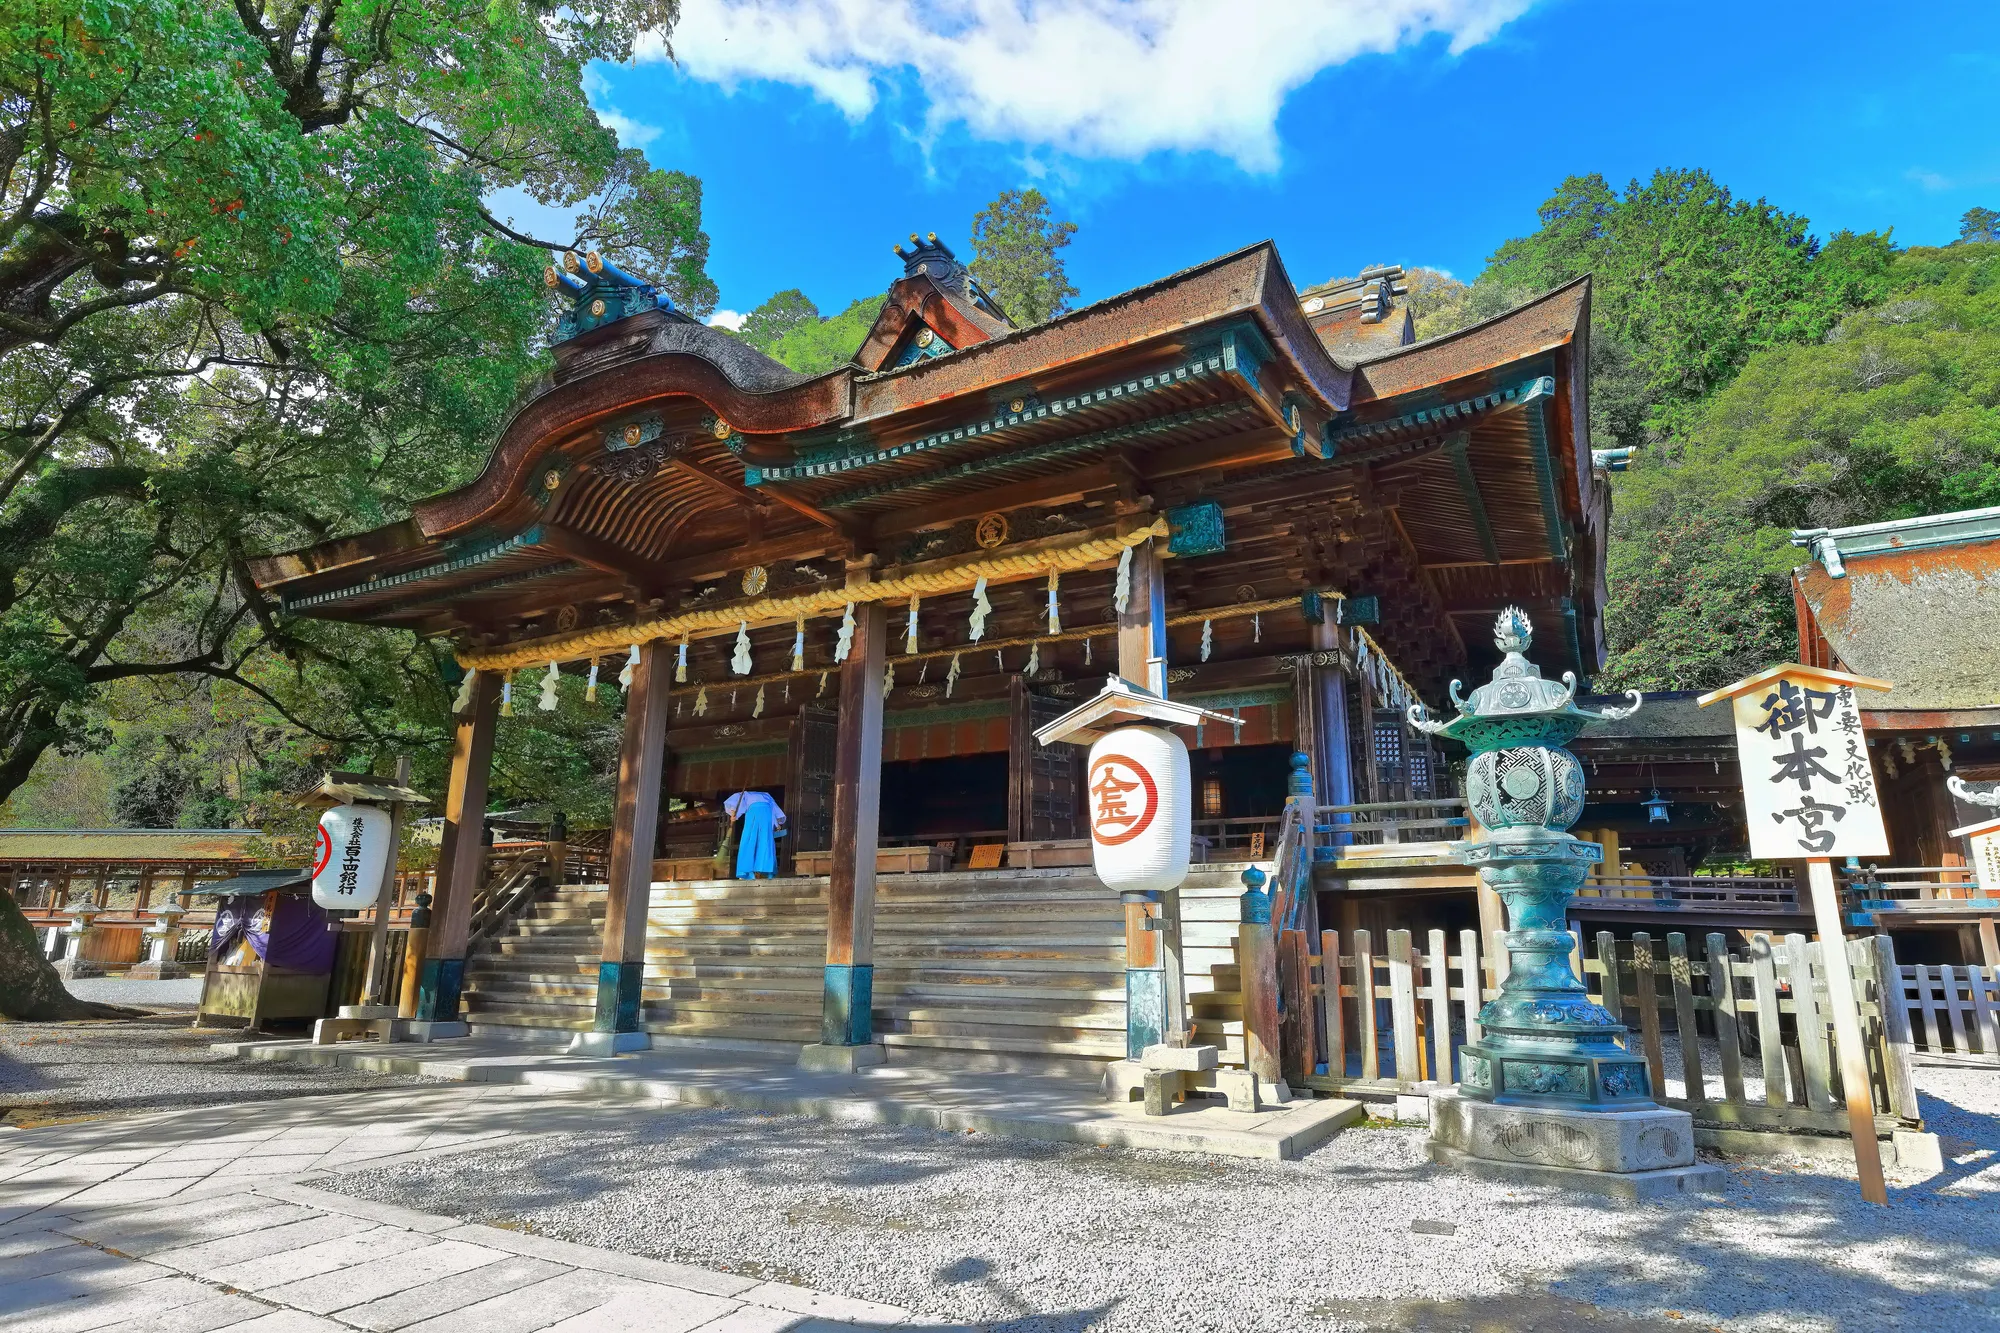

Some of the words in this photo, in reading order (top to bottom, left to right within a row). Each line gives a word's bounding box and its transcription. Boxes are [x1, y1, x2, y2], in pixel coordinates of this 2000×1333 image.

[1091, 767, 1141, 829] 金
[1749, 679, 1847, 853] 御本宮
[337, 817, 364, 896] 株式会社百十四銀行
